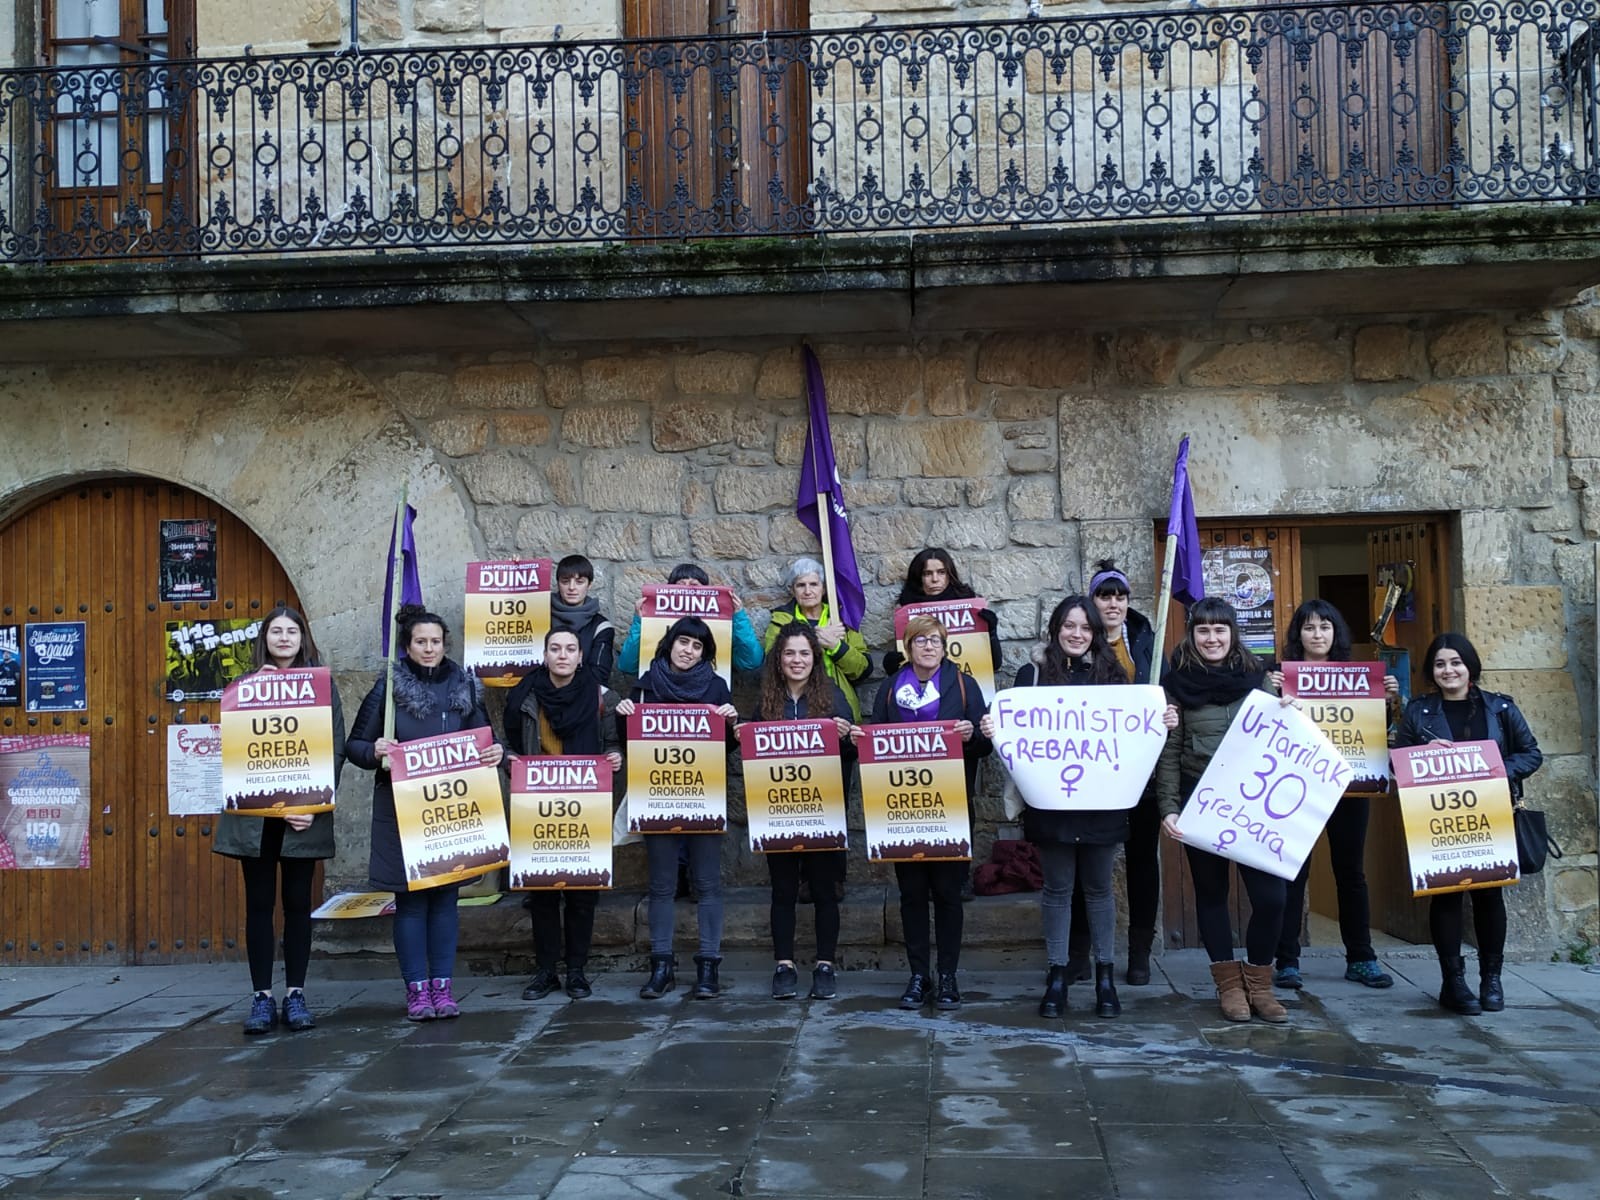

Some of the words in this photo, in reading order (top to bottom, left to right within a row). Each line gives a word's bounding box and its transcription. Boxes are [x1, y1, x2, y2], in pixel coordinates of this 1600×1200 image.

[480, 569, 539, 587] DUINA
[490, 600, 526, 615] U30
[656, 595, 719, 612] DUINA
[485, 620, 533, 635] GREBA
[909, 610, 975, 628] INA
[180, 621, 263, 656] hmend
[485, 635, 533, 645] OROKORRA
[238, 680, 315, 702] DUINA
[1298, 674, 1370, 691] DUINA
[1311, 706, 1354, 723] U30
[252, 716, 298, 735] U30
[642, 716, 711, 733] DUINA
[248, 739, 309, 759] GREBA
[755, 731, 825, 751] DUINA
[873, 734, 947, 755] DUINA
[405, 742, 480, 771] DUINA
[654, 748, 695, 765] U30
[1336, 746, 1366, 756] ORRA
[247, 757, 310, 770] OROKORRA
[1410, 753, 1490, 778] DUINA
[246, 776, 276, 784] HUELGA
[277, 773, 311, 782] GENERAL
[527, 767, 598, 785] DUINA
[650, 770, 704, 786] GREBA
[770, 765, 811, 782] U30
[889, 768, 933, 787] U30
[423, 779, 468, 802] U30
[649, 787, 705, 796] OROKORRA
[768, 787, 823, 804] GREBA
[1240, 754, 1306, 820] 30
[538, 800, 581, 817] U30
[768, 804, 824, 814] OROKORRA
[887, 792, 944, 809] GREBA
[1430, 790, 1477, 811] U30
[422, 801, 481, 825] GREBA
[888, 809, 946, 820] OROKORRA
[424, 818, 483, 838] OROKORRA
[534, 824, 590, 839] GREBA
[1197, 787, 1284, 862] Grebara
[1430, 814, 1491, 835] GREBA
[424, 839, 453, 852] HUELGA
[454, 833, 486, 846] GENERAL
[533, 840, 590, 850] OROKORRA
[1432, 832, 1492, 847] OROKORRA
[1432, 852, 1460, 862] HUELGA
[1462, 849, 1495, 858] GENERAL
